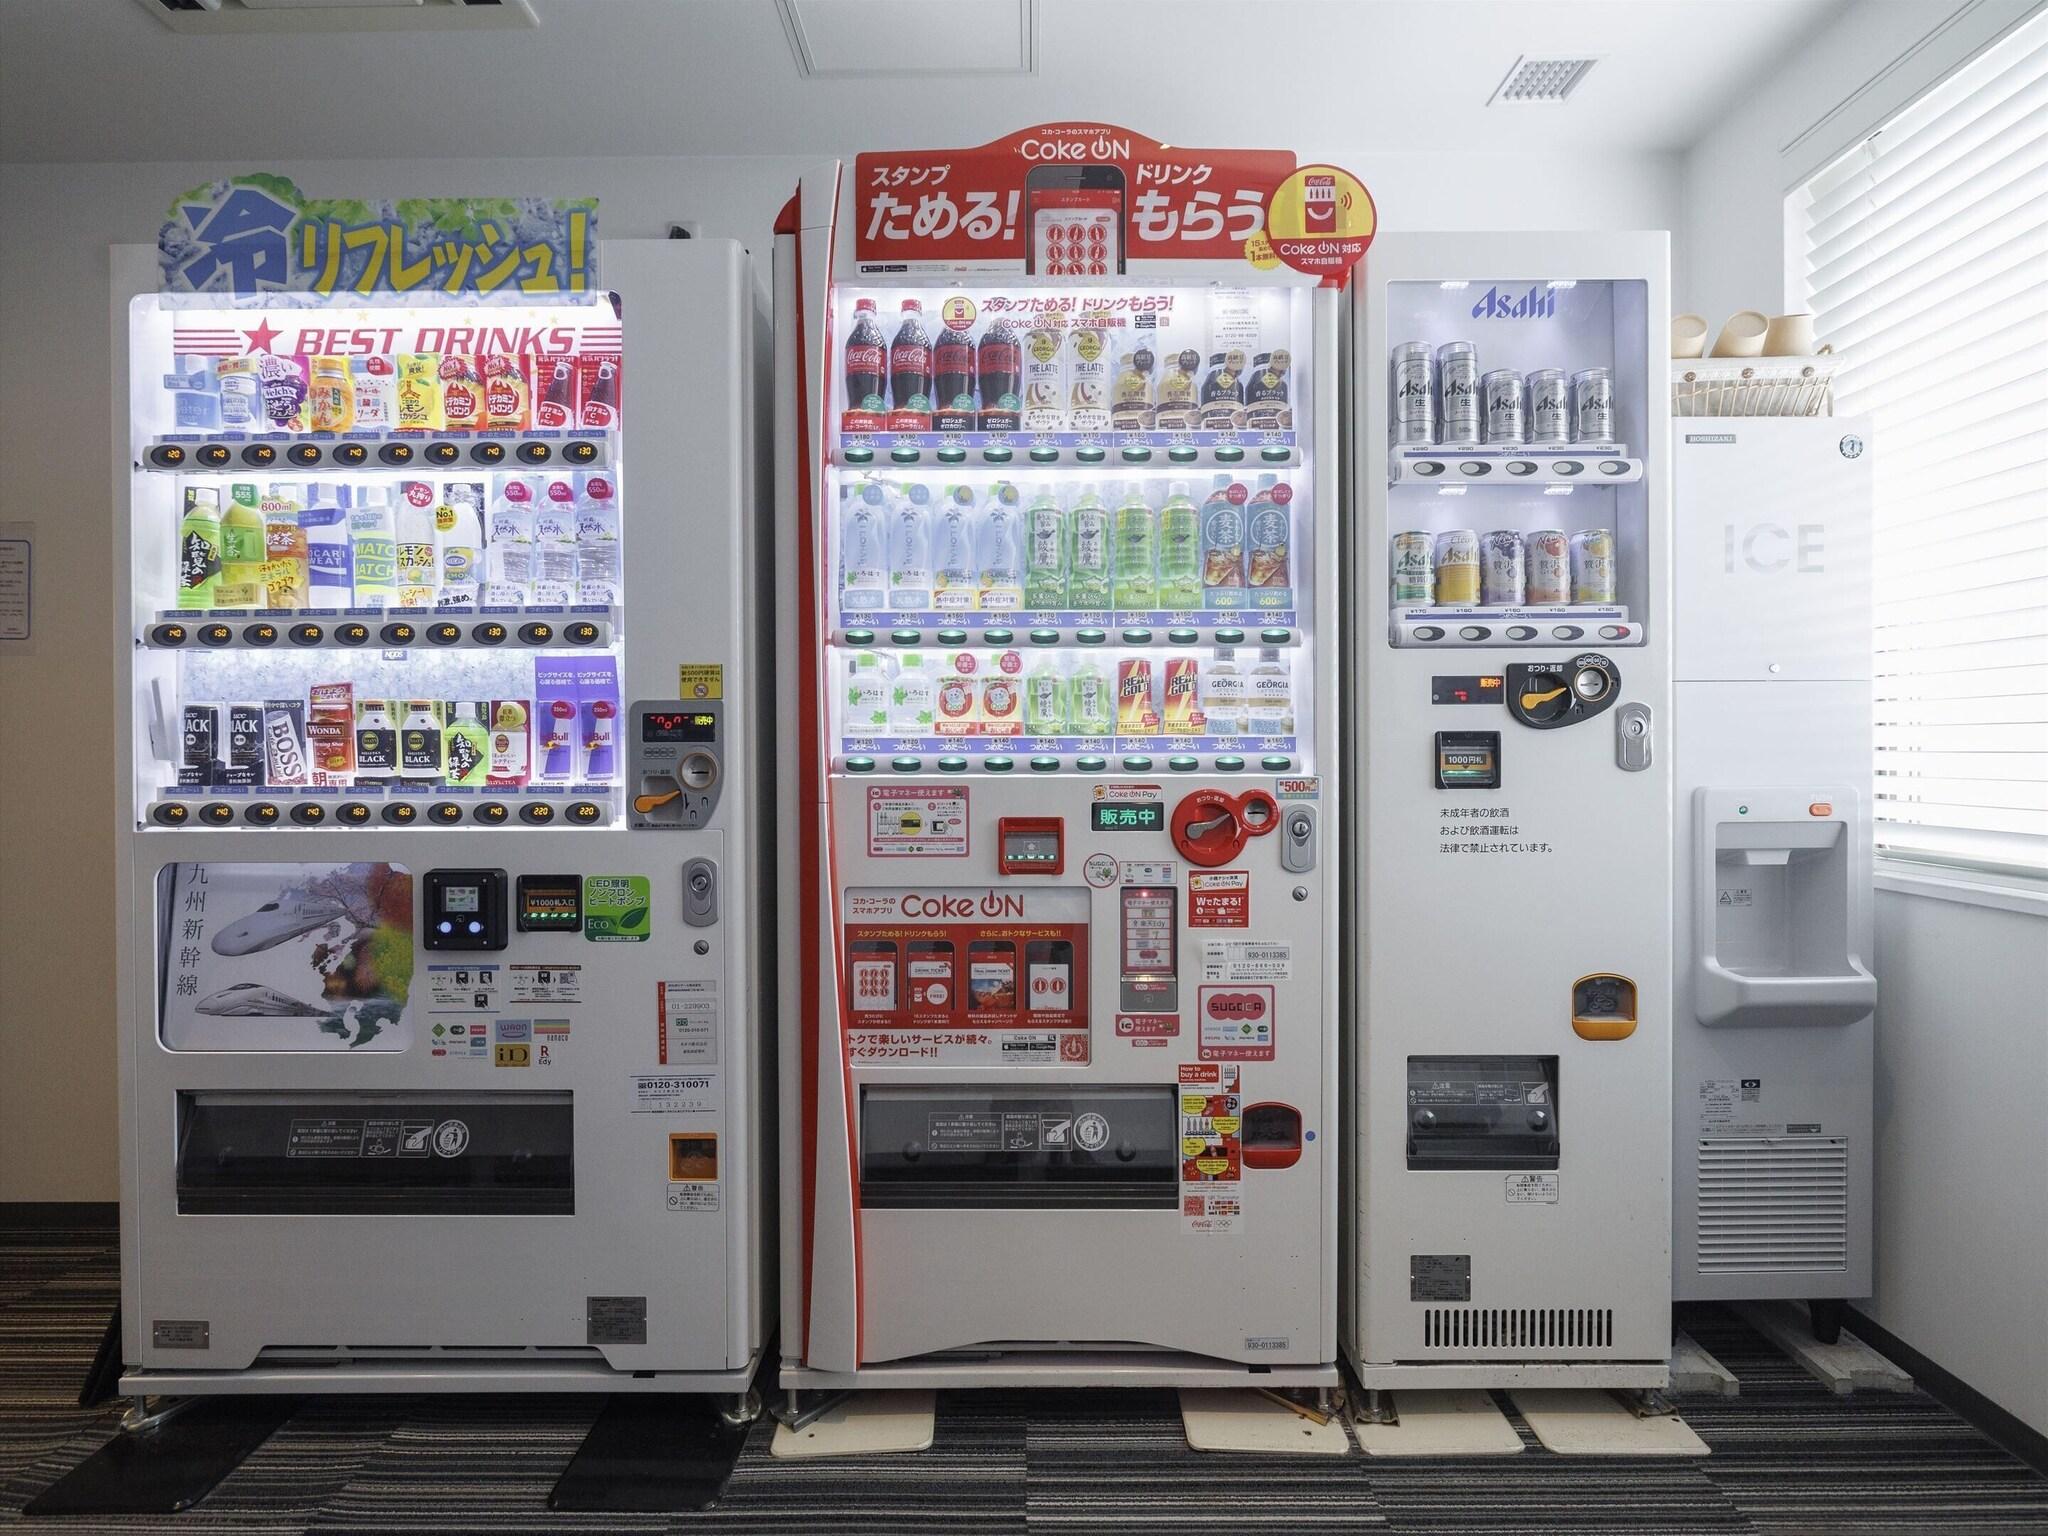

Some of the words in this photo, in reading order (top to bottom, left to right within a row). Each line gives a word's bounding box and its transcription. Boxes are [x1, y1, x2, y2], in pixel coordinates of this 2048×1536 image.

[1041, 128, 1111, 136] コカ・コーラのスマホアプリ
[1020, 139, 1087, 160] Coke
[1090, 135, 1130, 161] ON
[871, 164, 951, 187] スタンプ
[1136, 163, 1213, 185] ドリンク
[865, 190, 1021, 241] ためる!
[1131, 190, 1266, 242] もらう
[1280, 243, 1316, 255] Coke
[1318, 241, 1340, 255] ON
[1342, 243, 1362, 254] 対応
[1301, 257, 1343, 265] スマホ自販機
[981, 296, 1076, 313] スタンプためる!
[1081, 296, 1174, 312] ドリンクもらう!
[1471, 285, 1557, 319] Asahi
[1002, 319, 1032, 329] Coke
[1054, 319, 1069, 328] 対応
[1071, 318, 1127, 328] スマホ自販機
[294, 327, 403, 356] BEST
[415, 326, 576, 356] DRINKS
[848, 347, 882, 364] Coca-Cola
[893, 347, 927, 364] Coca-Cola
[1029, 364, 1040, 374] THE
[1041, 364, 1058, 374] LATTE
[1075, 363, 1087, 373] THE
[1087, 363, 1104, 373] LATTE
[167, 450, 180, 458] 120
[213, 449, 225, 458] 140
[258, 449, 271, 457] 140
[303, 448, 316, 457] 150
[350, 448, 362, 457] 140
[395, 448, 408, 456] 140
[441, 447, 453, 456] 140
[487, 447, 500, 455] 140
[533, 447, 545, 456] 130
[579, 447, 592, 455] 130
[1219, 513, 1234, 543] 麦茶
[1263, 513, 1279, 543] 麦茶
[1724, 522, 1825, 574] ICE
[169, 629, 181, 637] 140
[214, 628, 227, 637] 150
[259, 629, 272, 637] 140
[396, 628, 409, 637] 160
[442, 627, 455, 636] 120
[489, 627, 501, 636] 130
[536, 627, 547, 636] 130
[582, 627, 593, 636] 130
[1527, 664, 1563, 672] おつり・返却
[307, 725, 343, 736] WONDA
[552, 732, 569, 741] Bull
[594, 732, 611, 741] Bull
[273, 720, 302, 777] BOSS
[405, 755, 431, 763] BLACK
[1448, 755, 1484, 764] 1000円札
[311, 772, 327, 787] 朝
[1143, 791, 1157, 799] Pay
[171, 808, 183, 816] 140
[216, 808, 228, 816] 140
[262, 807, 273, 816] 140
[308, 808, 319, 816] 140
[352, 807, 365, 816] 160
[398, 808, 410, 816] 160
[444, 807, 457, 816] 120
[490, 807, 503, 815] 140
[534, 807, 548, 816] 220
[580, 807, 594, 816] 220
[1440, 808, 1509, 818] 未成年者の飲酒
[1100, 808, 1155, 825] 販売中
[1440, 825, 1519, 835] および飲酒運転は
[1440, 843, 1554, 853] 法律で禁止されています。
[589, 880, 630, 888] LED照明
[589, 888, 635, 897] ノンフロン
[530, 898, 576, 907] ¥1000札入口
[589, 896, 645, 906] ヒートポンプ
[852, 897, 896, 905] コカ・コーラの
[900, 894, 975, 918] Coke
[980, 889, 1024, 918] ON
[1196, 896, 1242, 906] Wでたまる!
[177, 864, 208, 996] 九州新幹線
[647, 1081, 709, 1089] 0120-310071
